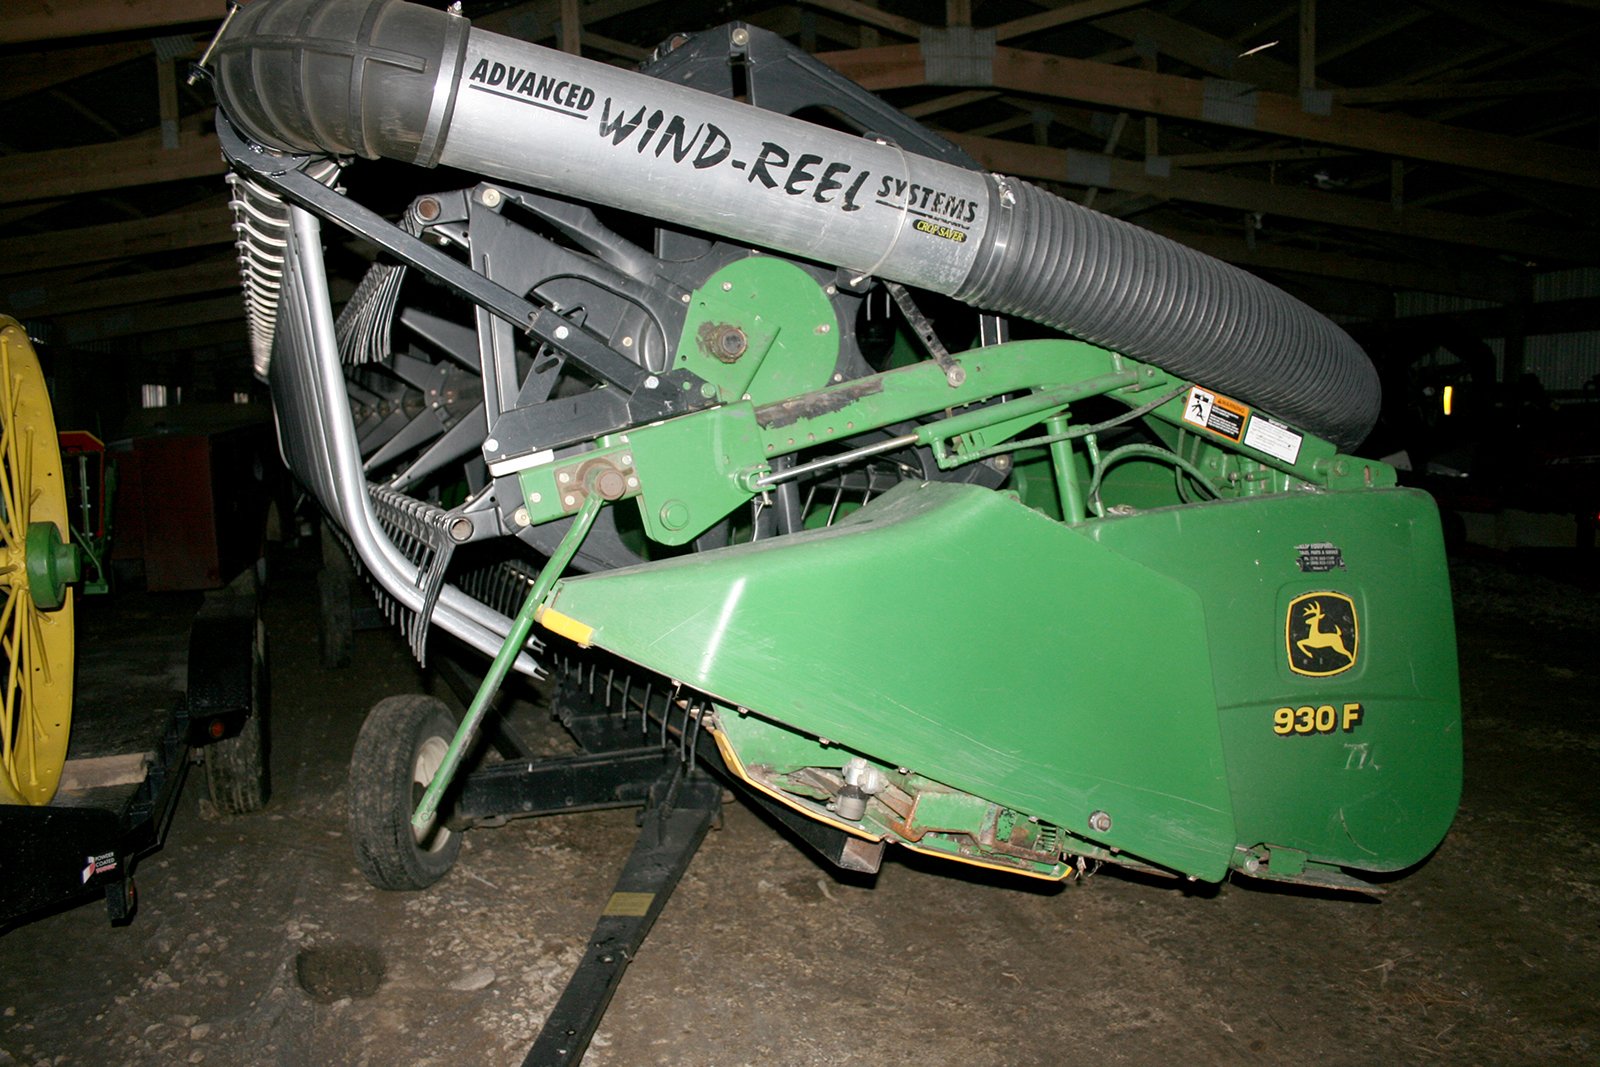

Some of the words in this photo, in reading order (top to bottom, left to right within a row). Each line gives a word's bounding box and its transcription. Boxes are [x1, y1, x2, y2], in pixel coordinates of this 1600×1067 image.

[470, 58, 595, 112] ADVANCED
[598, 97, 872, 212] WIND-REEL
[877, 175, 979, 223] SYSTEMS
[938, 226, 965, 242] SAVER
[1273, 705, 1338, 737] 930
[1342, 702, 1364, 733] F
[96, 858, 115, 867] COATED
